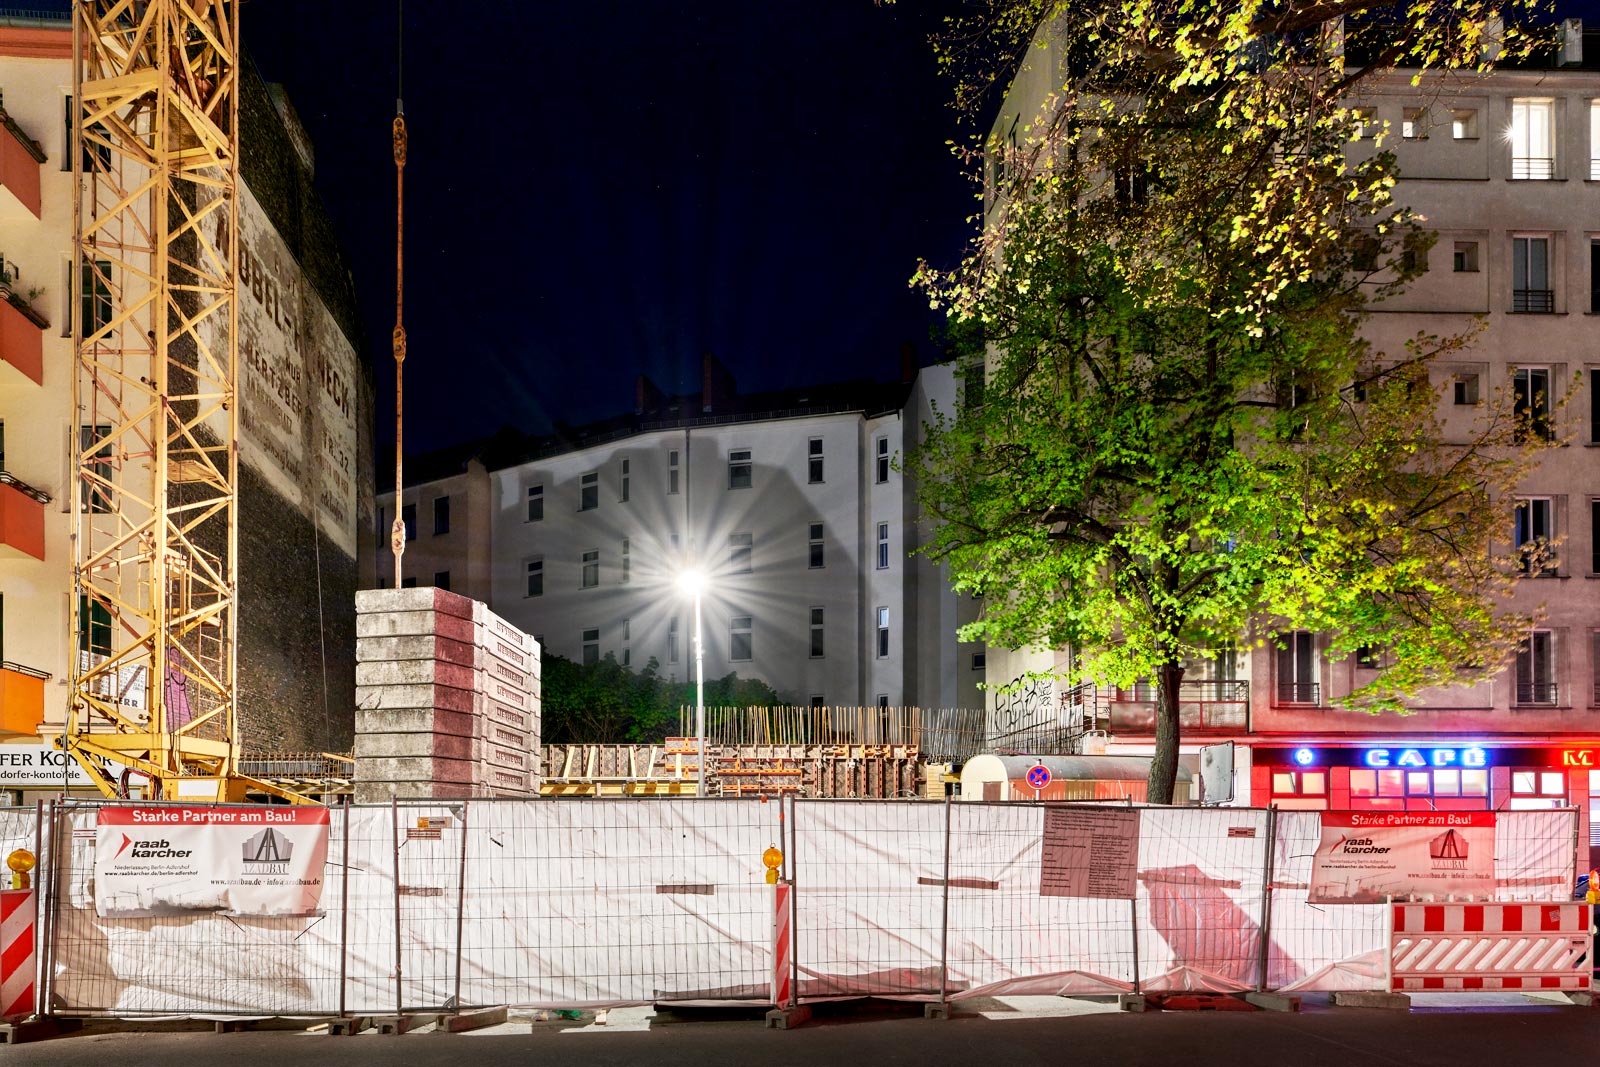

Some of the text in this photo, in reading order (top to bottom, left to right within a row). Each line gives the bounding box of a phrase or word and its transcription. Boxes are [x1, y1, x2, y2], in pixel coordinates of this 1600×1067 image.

[0, 750, 113, 766] FER KONR
[1367, 747, 1487, 767] CAFÉ
[0, 770, 80, 779] dorfer-kontorde
[133, 810, 296, 822] Starke Partner am Bau!
[1351, 814, 1472, 825] Starke Partner am Bau!
[133, 839, 170, 849] raab
[1345, 837, 1373, 846] raab
[131, 848, 192, 858] karcher
[1343, 845, 1391, 854] karcher
